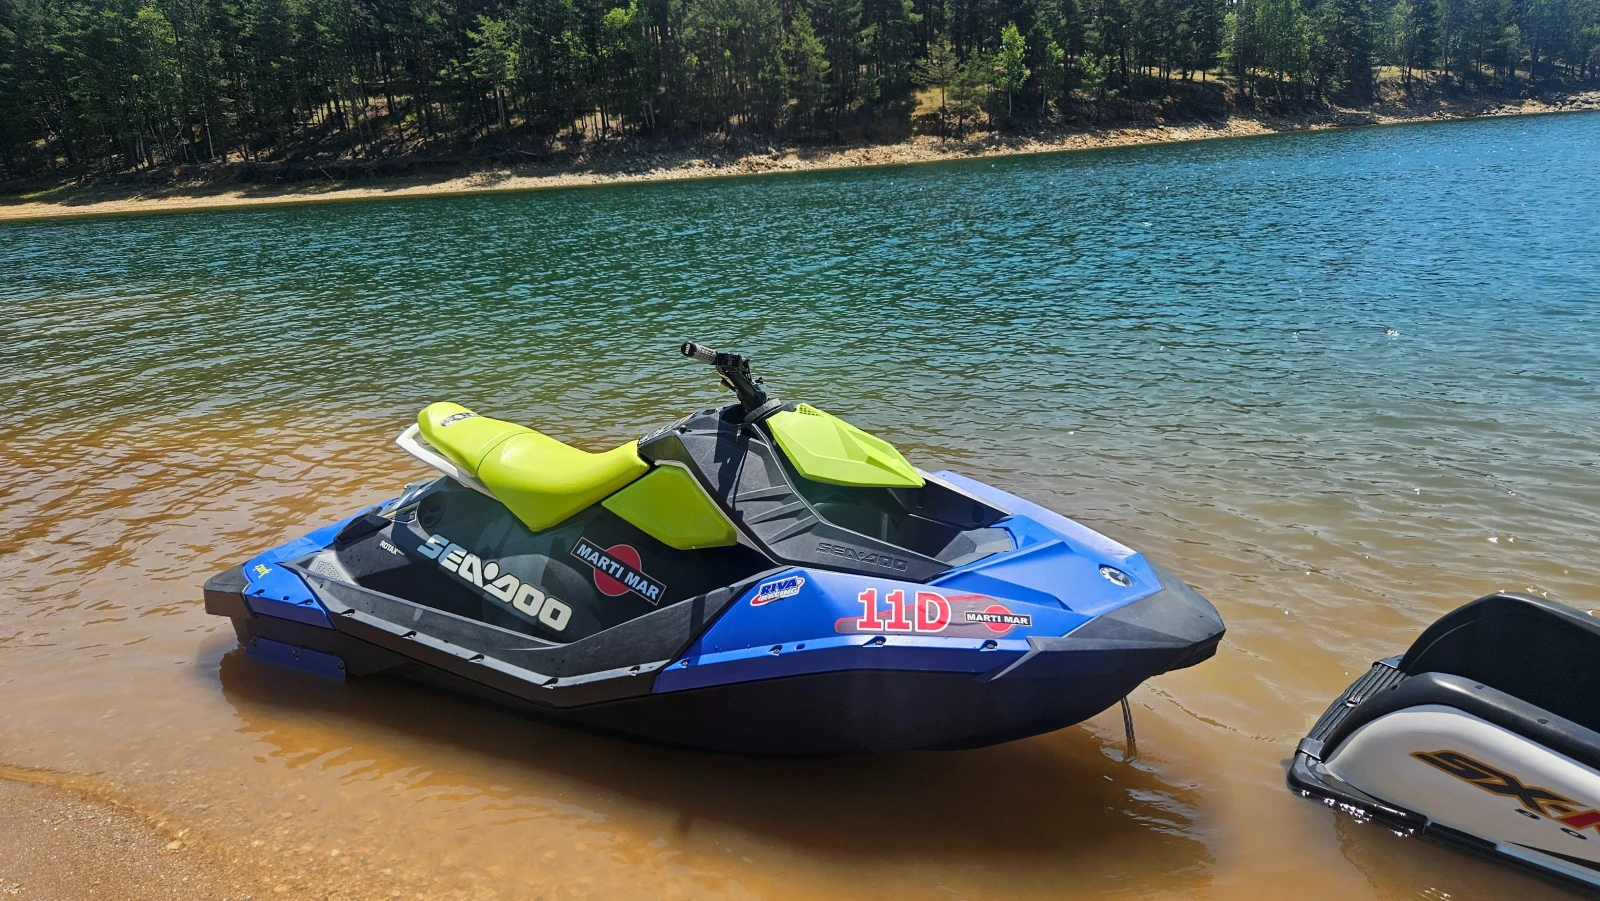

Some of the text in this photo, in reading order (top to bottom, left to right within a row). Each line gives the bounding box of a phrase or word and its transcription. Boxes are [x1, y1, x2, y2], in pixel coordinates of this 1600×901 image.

[379, 539, 399, 556] ROTAX
[576, 543, 660, 601] MARTI MAR
[760, 578, 797, 595] RIVA
[857, 587, 952, 633] 11D
[966, 613, 1029, 625] MARTI MAR
